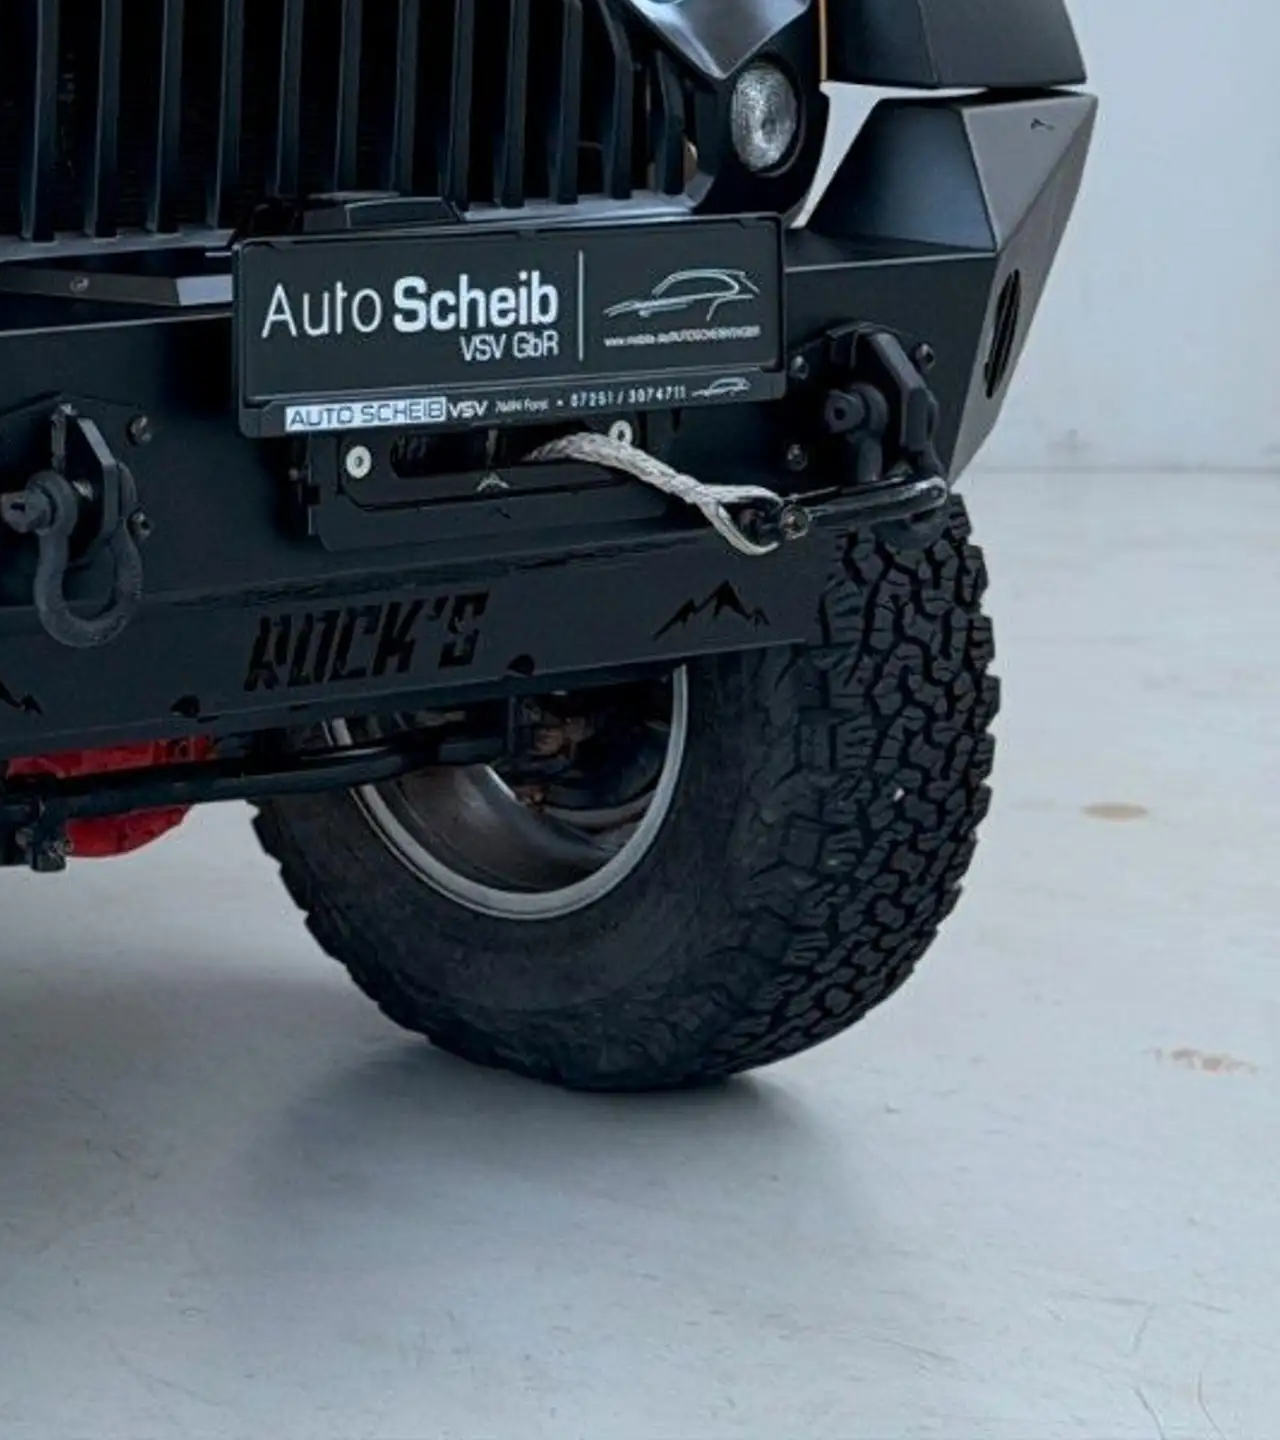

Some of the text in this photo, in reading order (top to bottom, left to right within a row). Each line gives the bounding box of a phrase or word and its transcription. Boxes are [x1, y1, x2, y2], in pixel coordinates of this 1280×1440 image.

[260, 269, 559, 340] Auto Scheib
[459, 330, 560, 363] VSV GbR
[289, 405, 354, 428] AUTO
[360, 399, 445, 425] SCHEIB
[448, 400, 489, 419] VSV
